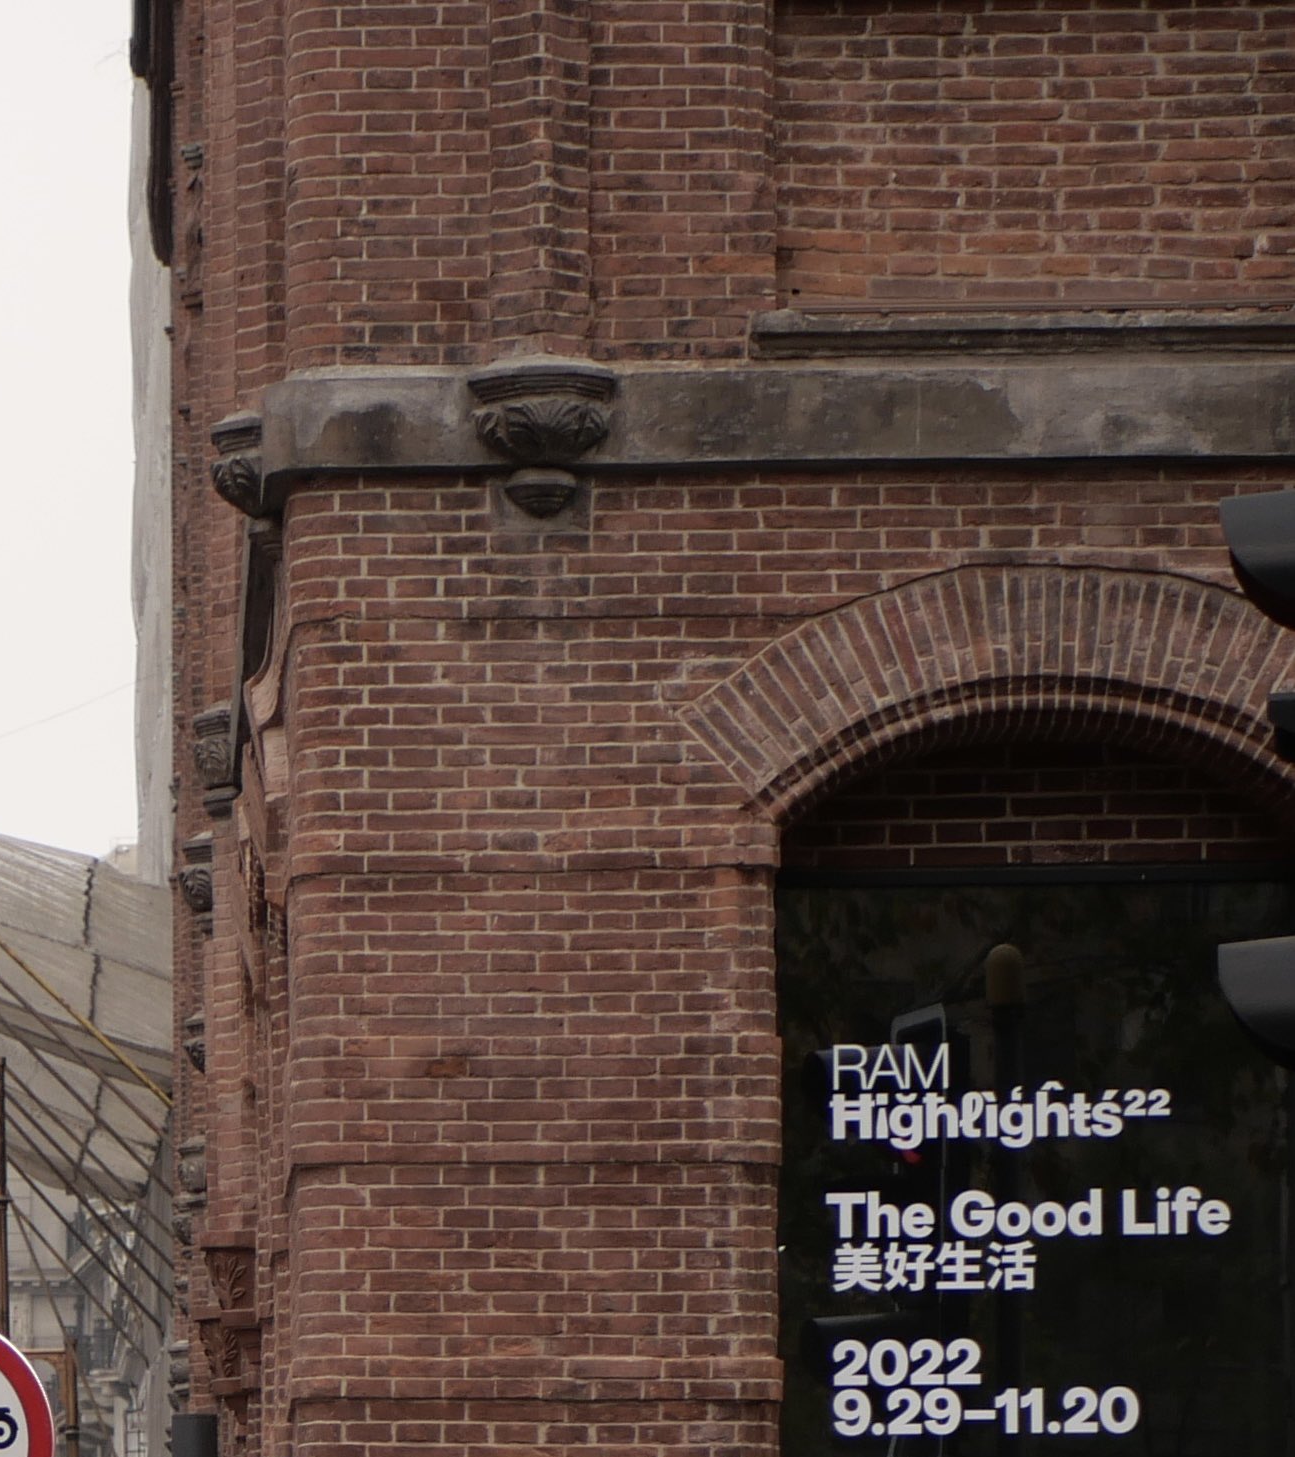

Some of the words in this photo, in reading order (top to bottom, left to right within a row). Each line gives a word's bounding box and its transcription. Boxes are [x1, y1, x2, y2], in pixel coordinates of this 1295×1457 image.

[832, 1042, 950, 1090] RAM
[825, 1190, 935, 1238] The
[950, 1188, 1103, 1237] Good
[1122, 1186, 1231, 1235] Life
[832, 1241, 1037, 1292] 美好生活
[832, 1338, 982, 1387] 2022
